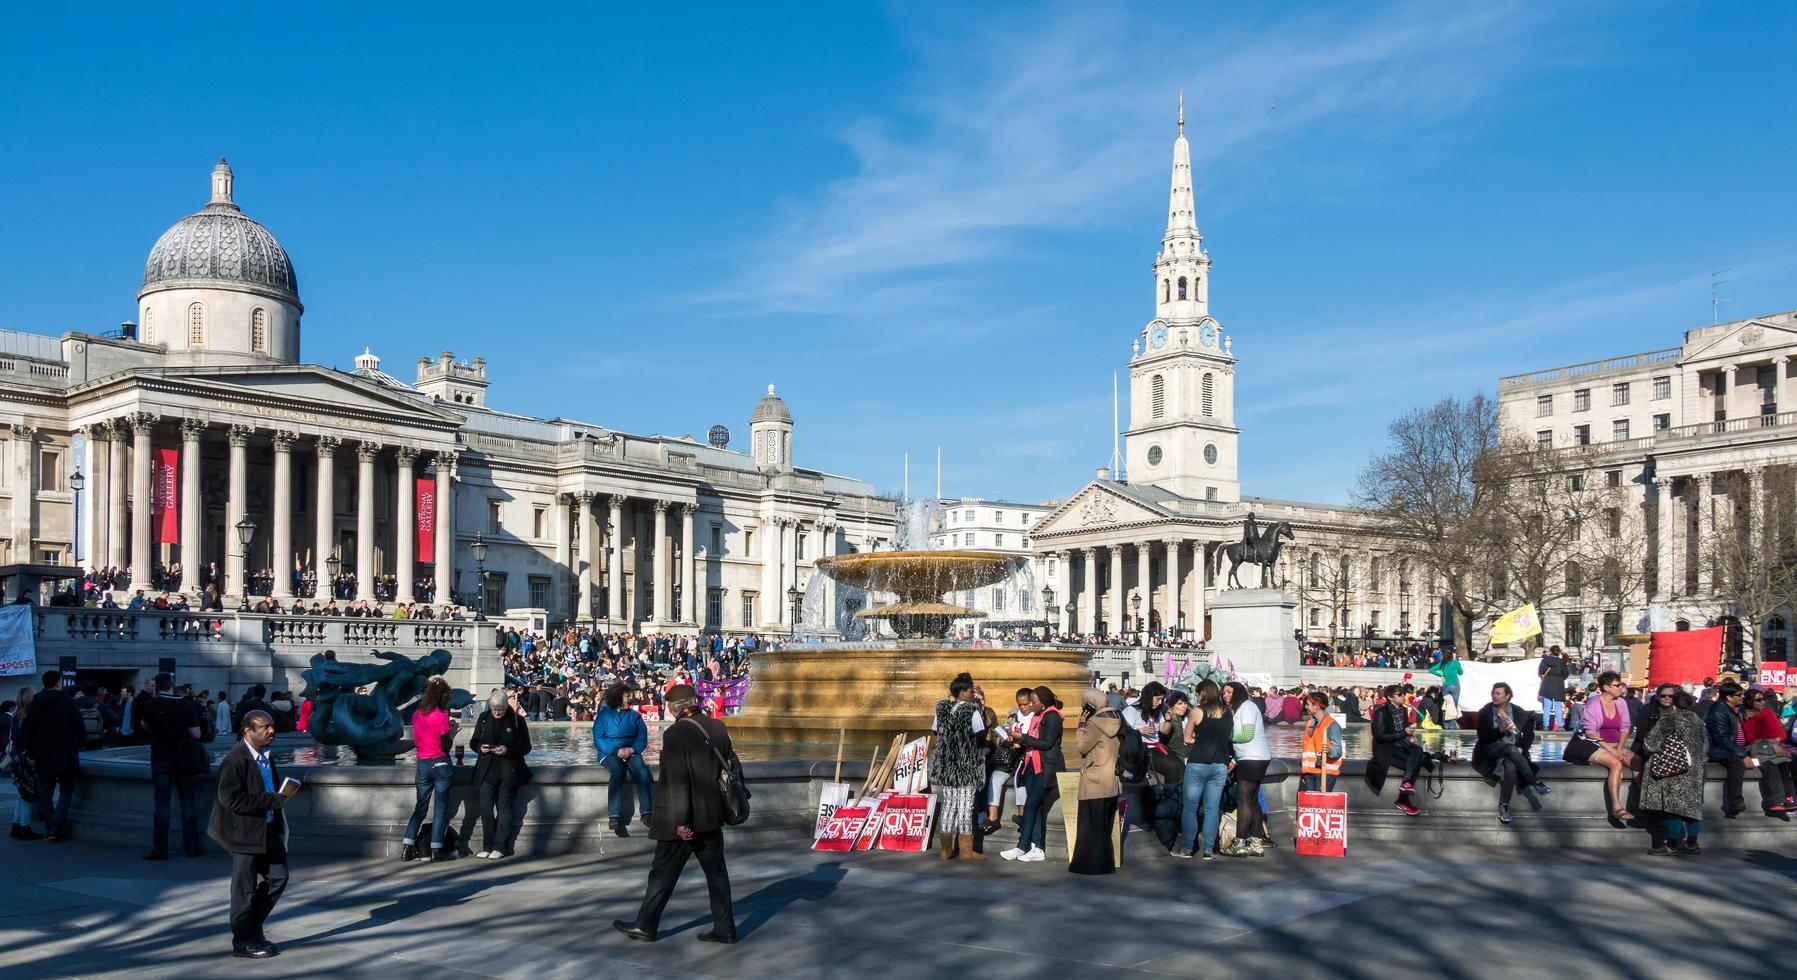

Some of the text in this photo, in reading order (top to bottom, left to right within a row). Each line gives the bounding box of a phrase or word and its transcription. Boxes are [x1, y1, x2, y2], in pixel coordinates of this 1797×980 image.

[0, 659, 34, 670] XPOSES
[1761, 674, 1786, 682] END
[895, 759, 923, 781] RISE
[820, 804, 843, 817] ISE
[885, 813, 925, 829] END
[1299, 813, 1344, 832] END
[827, 822, 862, 833] END
[906, 828, 922, 836] WE
[1298, 828, 1342, 839] WE CAN
